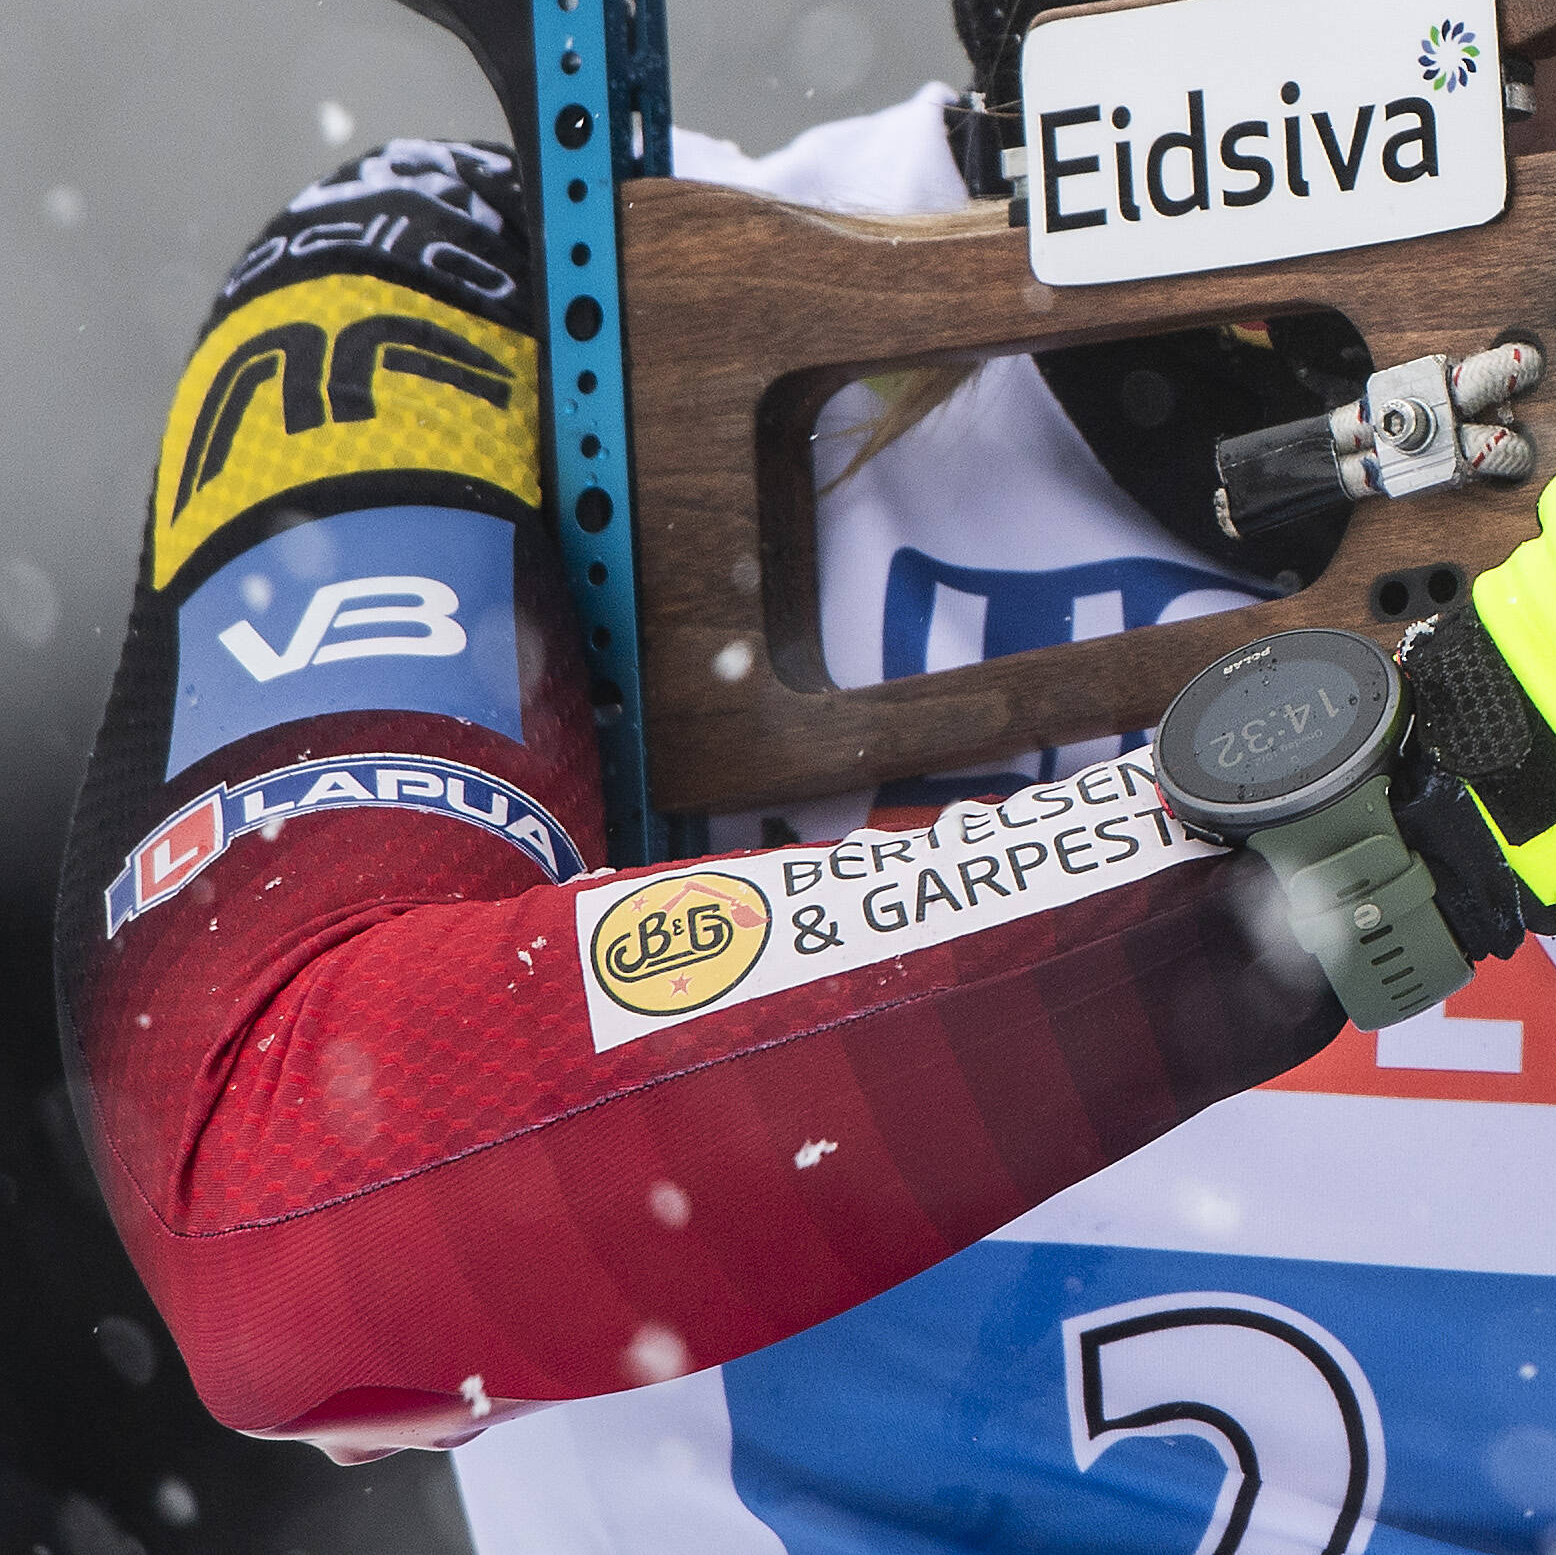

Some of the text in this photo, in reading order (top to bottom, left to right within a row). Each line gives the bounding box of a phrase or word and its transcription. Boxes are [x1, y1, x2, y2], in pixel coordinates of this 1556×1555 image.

[1039, 81, 1440, 234] Eidsiva
[218, 576, 468, 682] VB
[1222, 646, 1272, 676] POLAR
[1209, 688, 1340, 768] 14:32
[243, 769, 560, 874] LAPUA
[782, 760, 1157, 897] BERTELSEN
[791, 806, 1190, 956] & GARPEST
